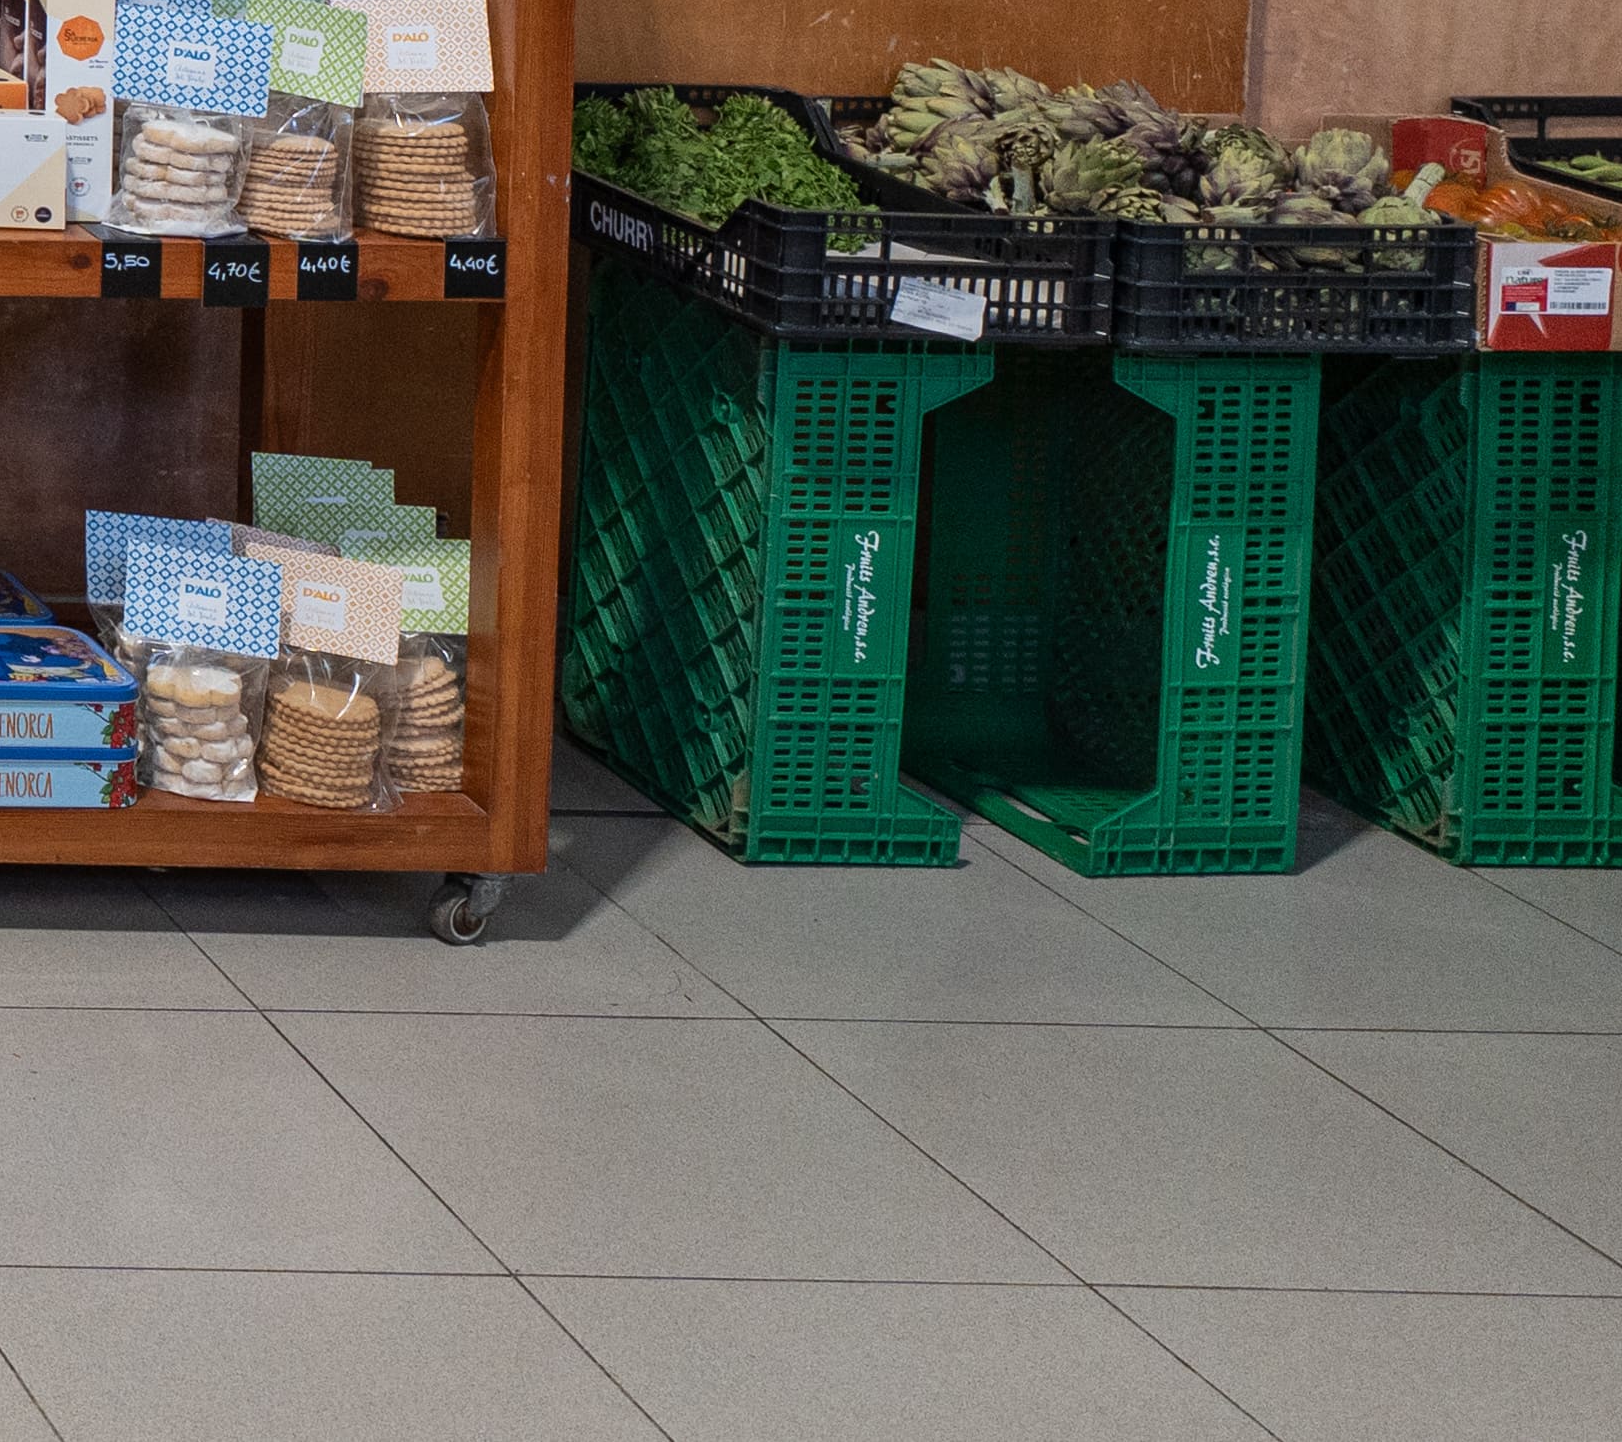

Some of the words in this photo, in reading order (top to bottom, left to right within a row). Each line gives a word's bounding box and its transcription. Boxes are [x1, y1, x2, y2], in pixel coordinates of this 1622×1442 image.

[288, 32, 319, 48] D'ALÓ
[392, 31, 430, 43] D'ALÓ
[173, 46, 211, 62] D'ALÓ
[207, 262, 263, 283] 4,70€
[300, 254, 351, 274] 4,40€
[449, 254, 500, 275] 4,40€
[854, 530, 880, 583] Fruits
[1562, 529, 1587, 582] Fruits
[184, 584, 222, 599] D'ALÓ
[302, 586, 341, 603] D'ALÓ
[1195, 617, 1221, 669] Fruits
